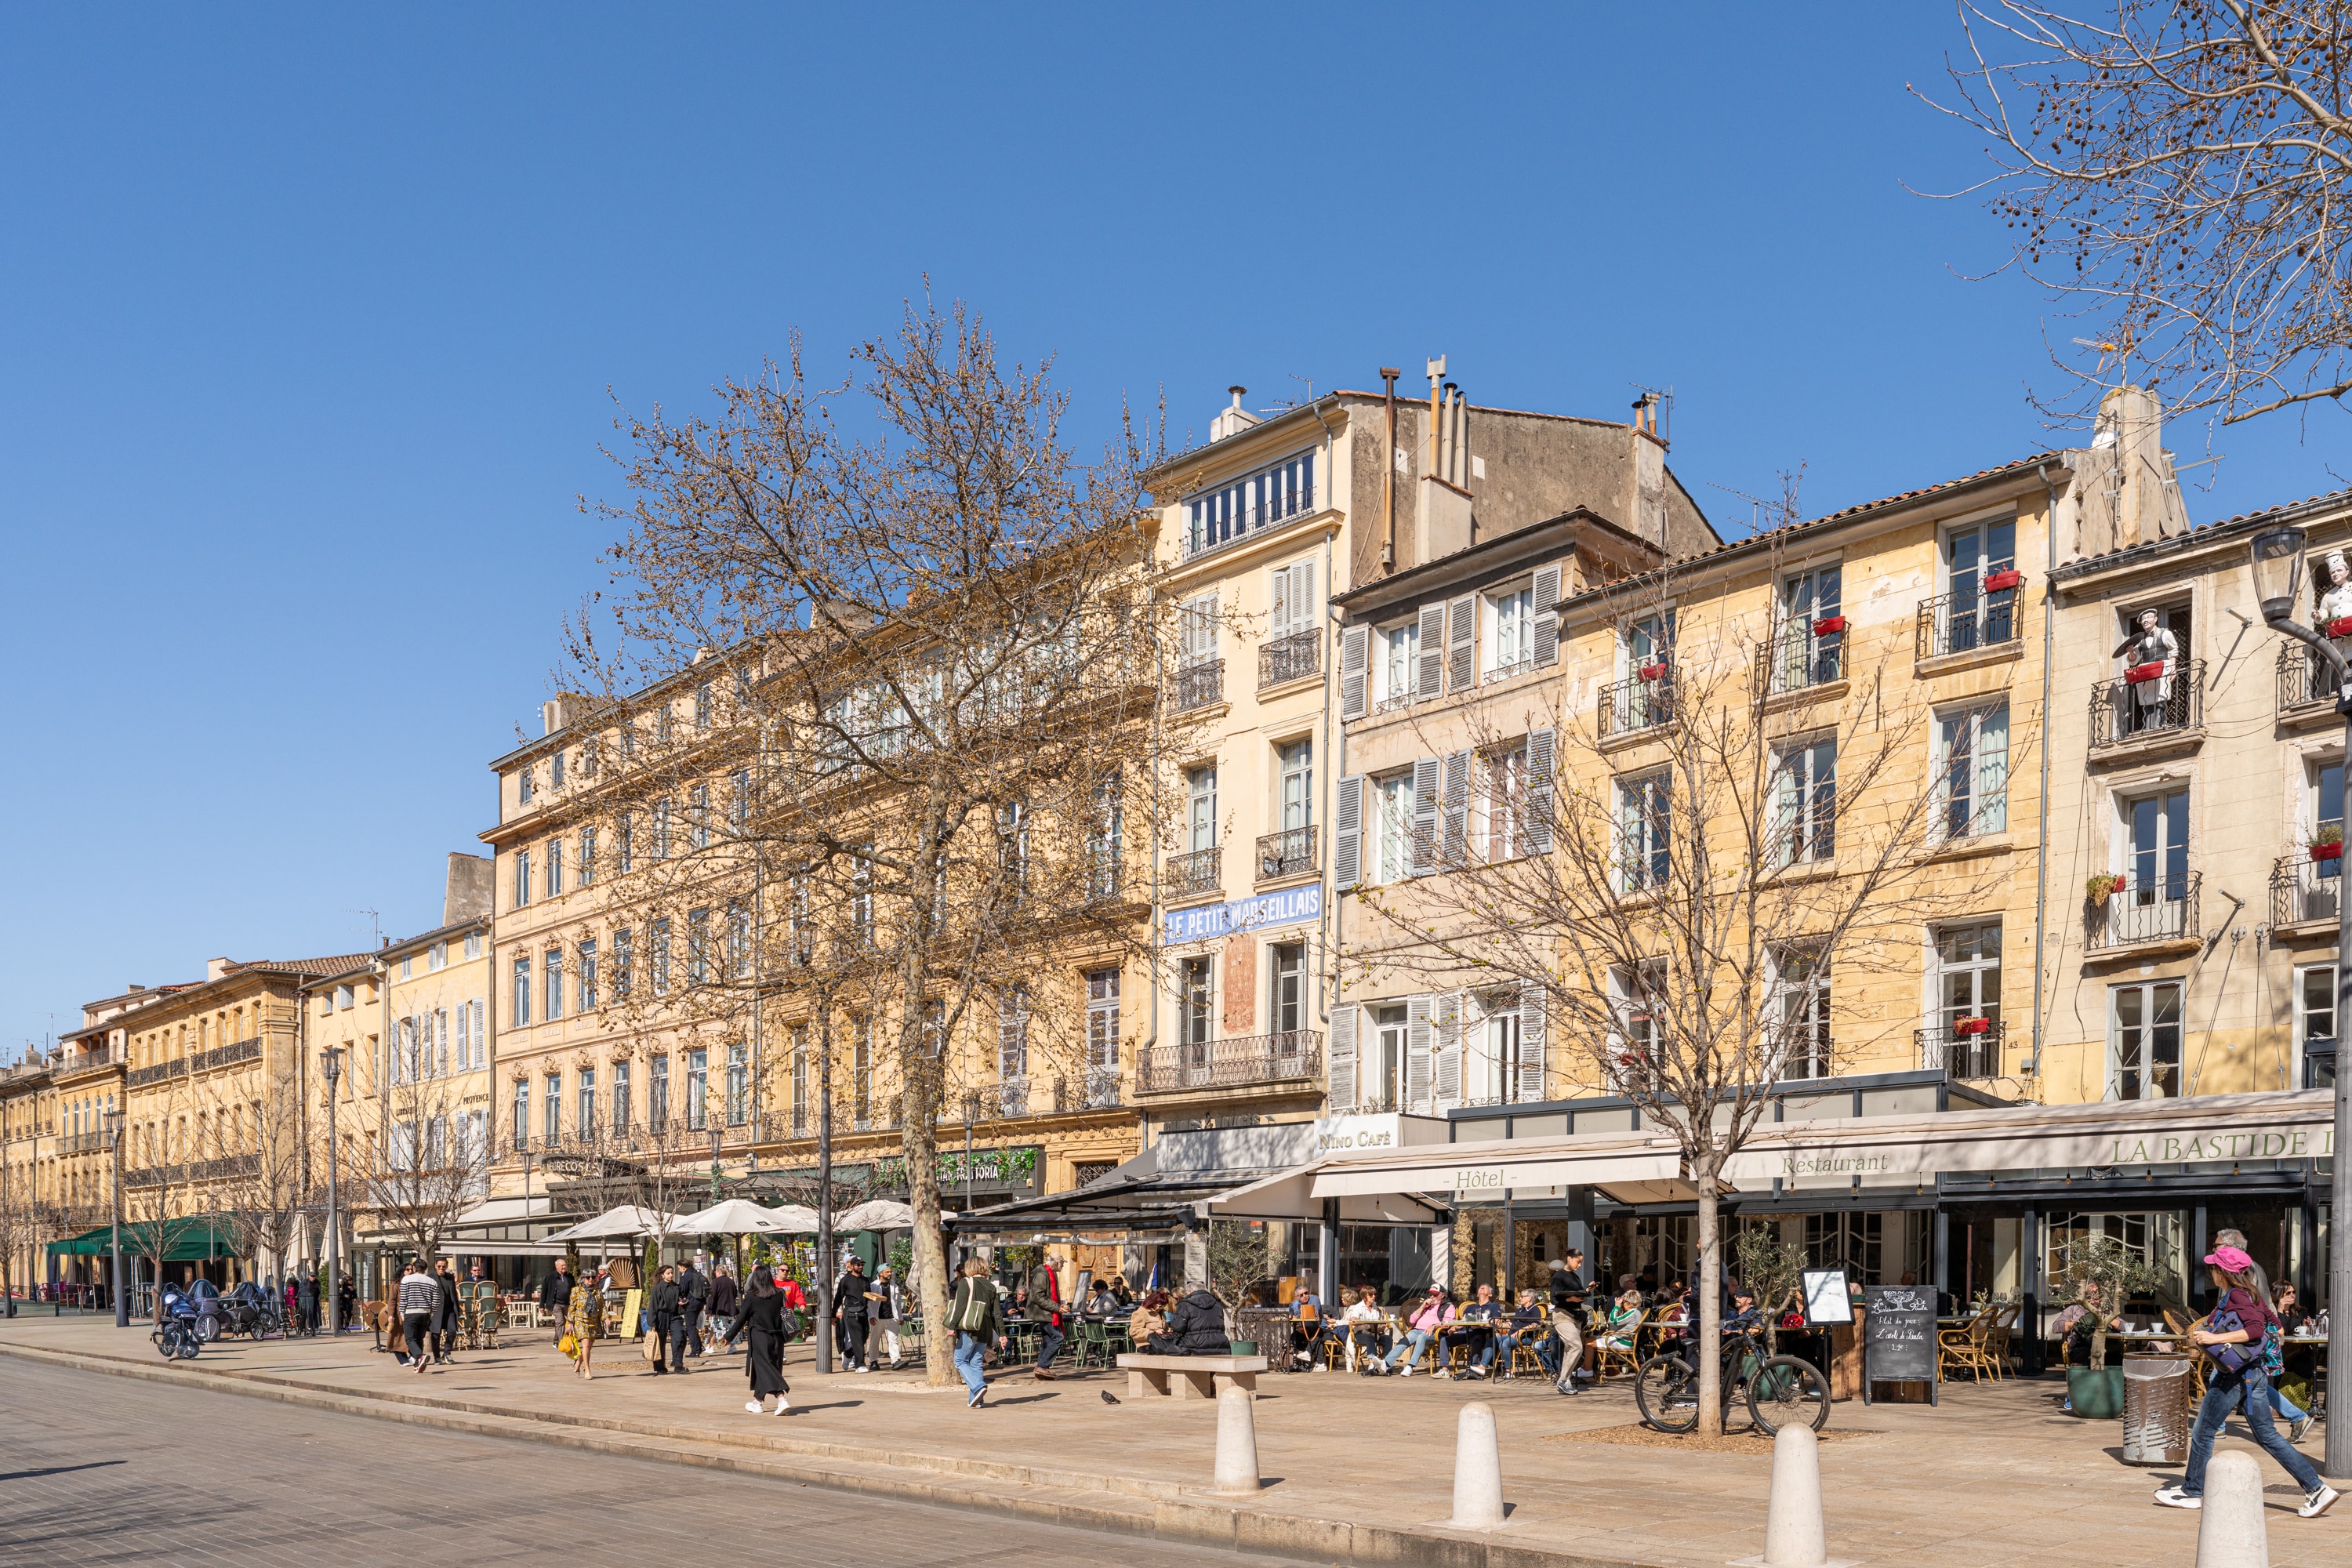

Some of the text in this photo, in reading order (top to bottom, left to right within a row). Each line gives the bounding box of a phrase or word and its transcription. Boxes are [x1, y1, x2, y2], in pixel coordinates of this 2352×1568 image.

[1169, 889, 1319, 939] LE PETIT MARSEILLAIS
[463, 1093, 489, 1105] PROVENCE
[1319, 1131, 1391, 1149] NINO CAFÉ
[2110, 1140, 2150, 1163] LA
[2161, 1131, 2309, 1160] BASTIDE
[956, 1165, 999, 1181] TRTTORIA
[1782, 1154, 1889, 1174] Restaurant
[1456, 1169, 1504, 1189] Hôtel
[1878, 1316, 1892, 1325] Plat
